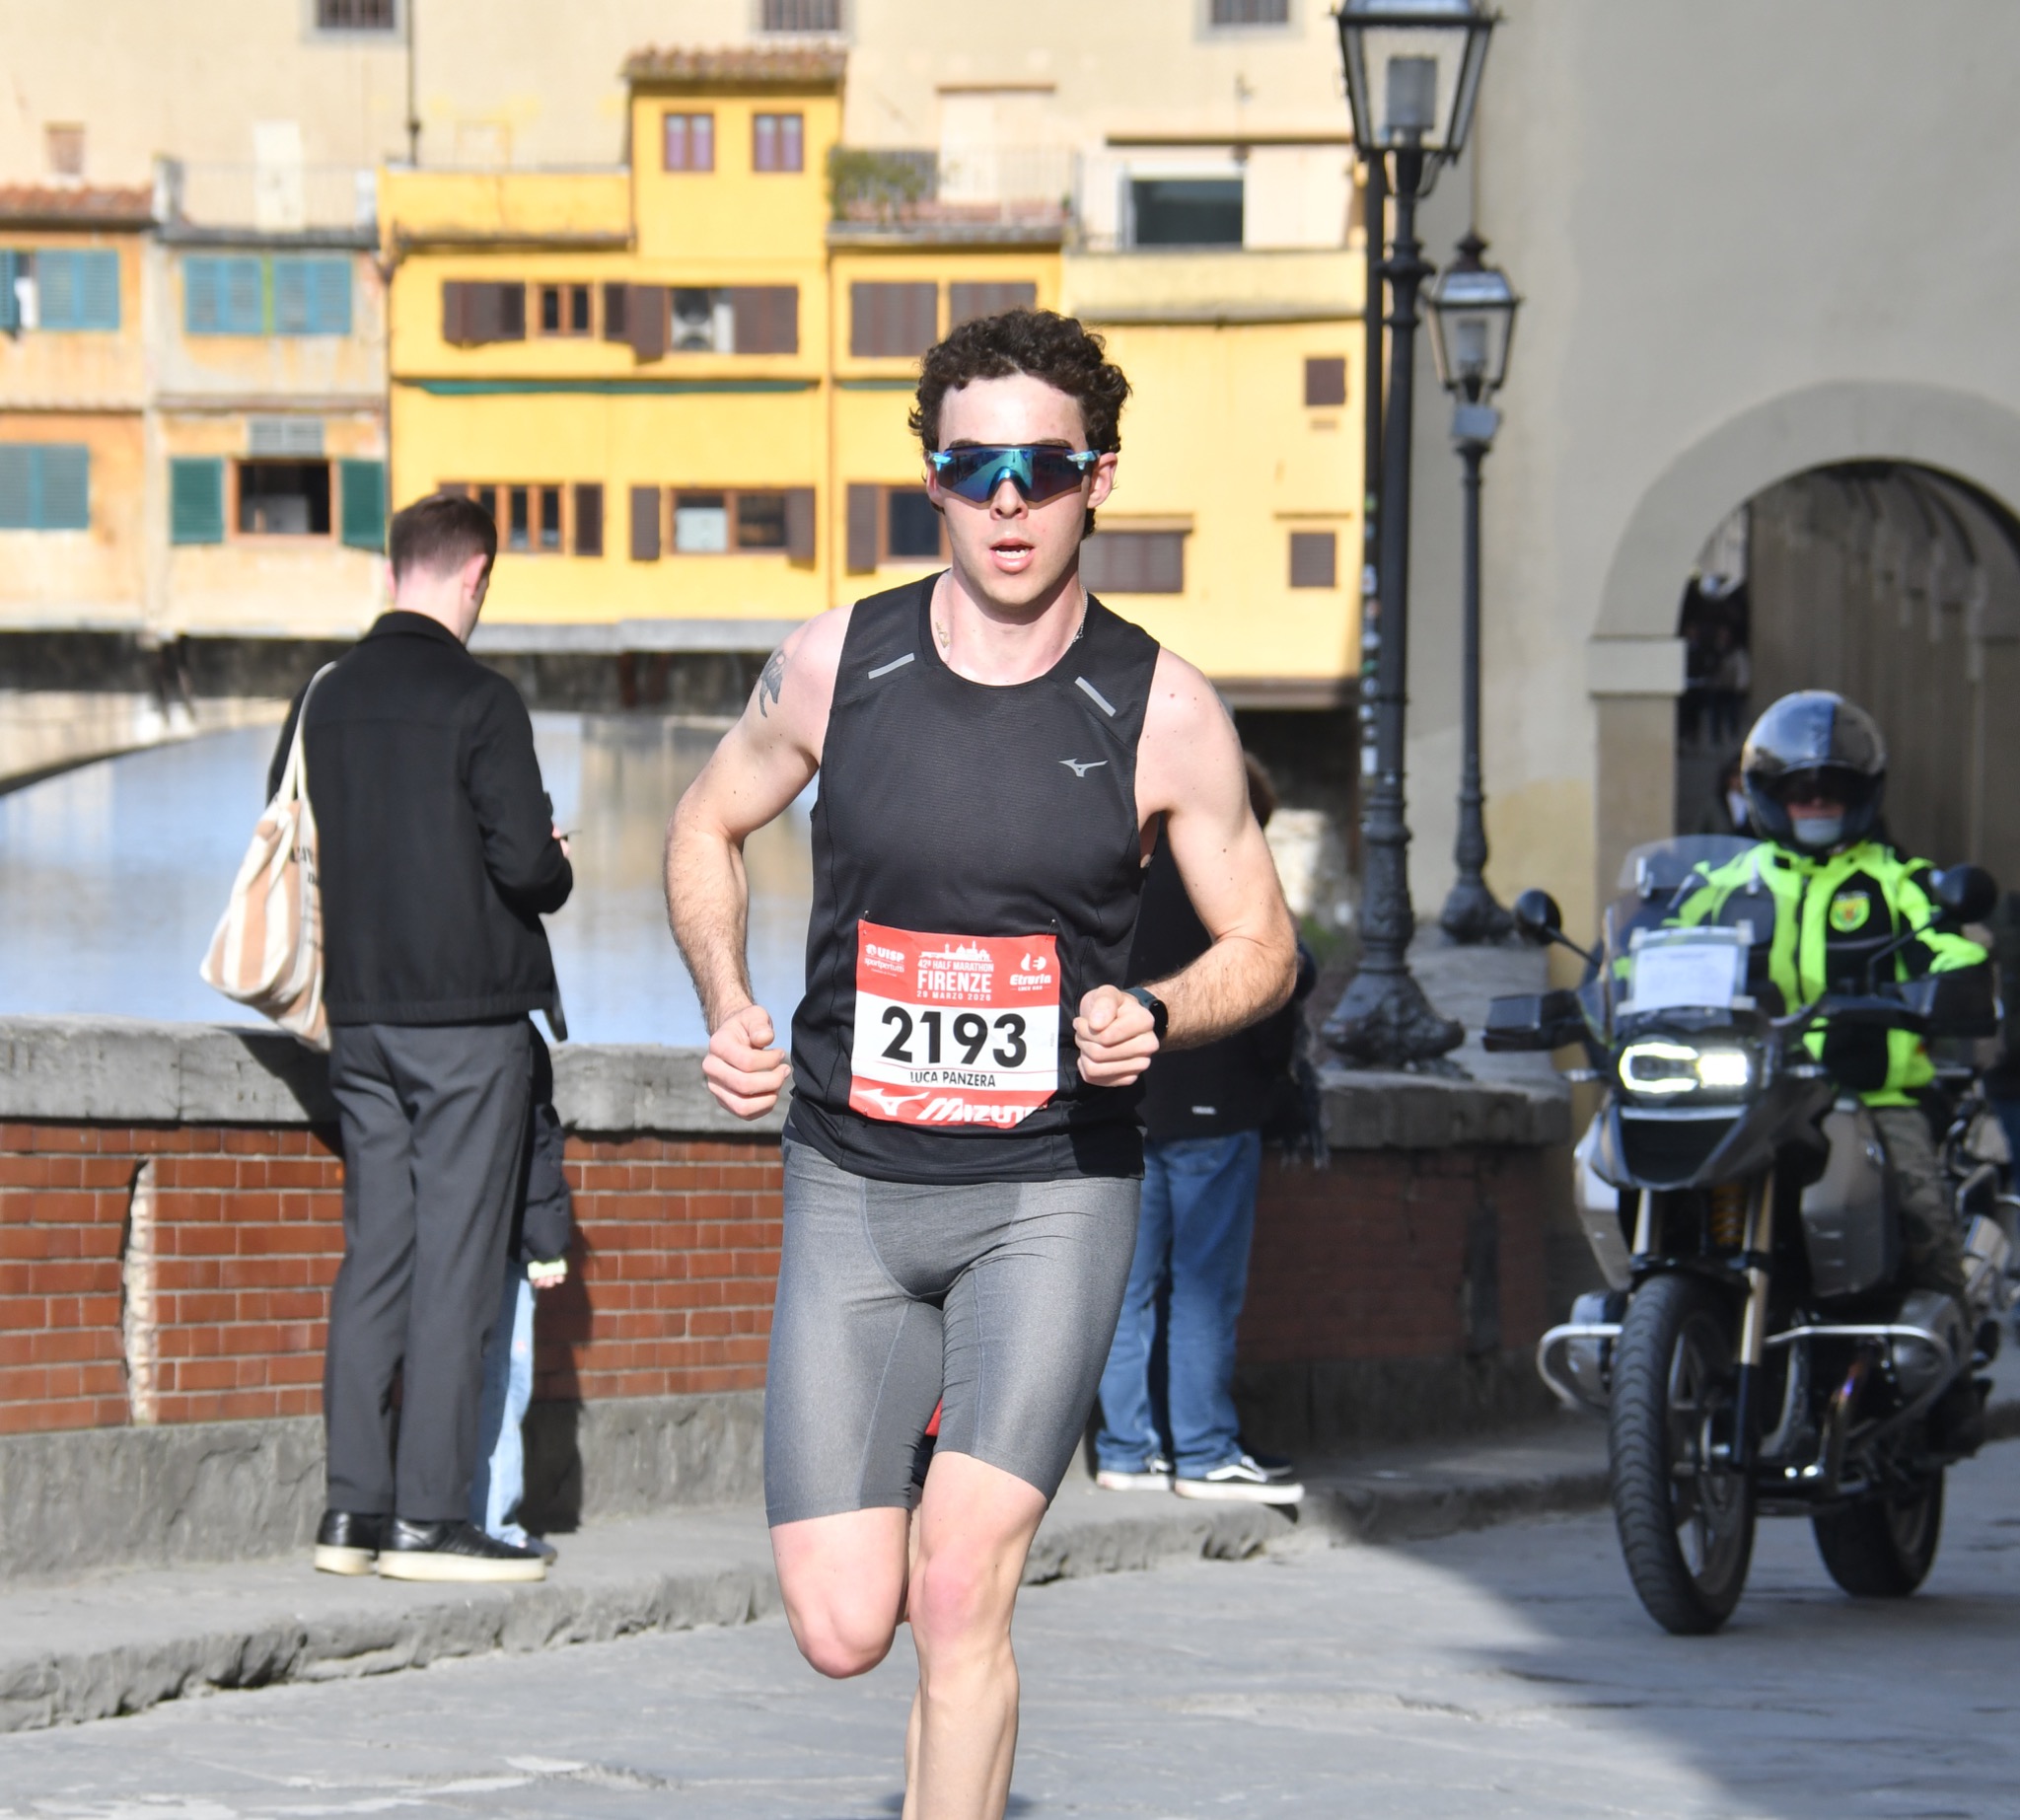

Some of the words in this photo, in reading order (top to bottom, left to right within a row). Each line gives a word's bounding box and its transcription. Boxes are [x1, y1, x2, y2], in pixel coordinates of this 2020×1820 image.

[878, 946, 905, 962] UISP
[932, 960, 952, 970] HALF
[953, 961, 994, 973] MARATHON
[917, 969, 992, 993] FIRENZE
[1009, 973, 1052, 985] Etruria
[932, 991, 964, 1000] MARZO
[881, 1005, 1028, 1068] 2193
[909, 1071, 938, 1083] LUCA
[943, 1071, 996, 1087] PANZERA
